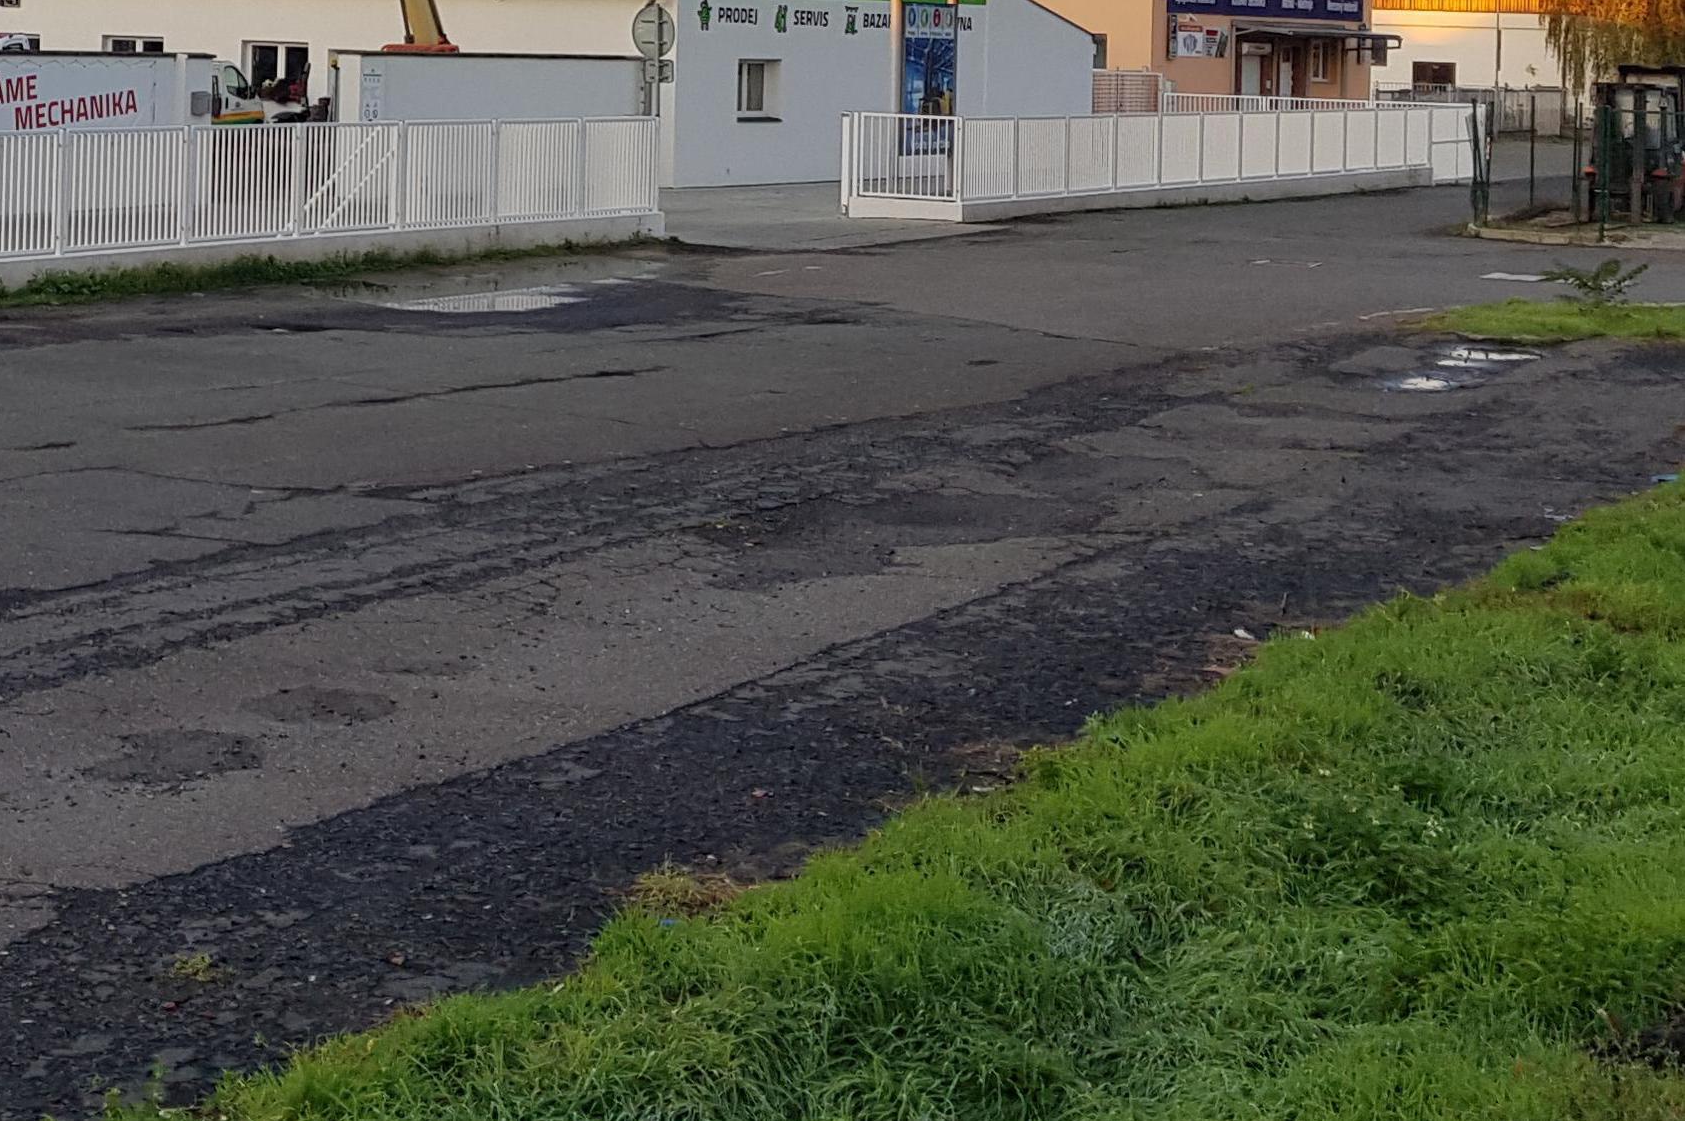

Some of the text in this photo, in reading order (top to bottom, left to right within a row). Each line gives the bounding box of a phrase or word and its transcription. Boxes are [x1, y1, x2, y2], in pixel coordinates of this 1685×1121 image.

[718, 7, 759, 26] PRODEJ
[793, 10, 830, 29] SERVIS
[15, 90, 138, 130] MECHANIKA
